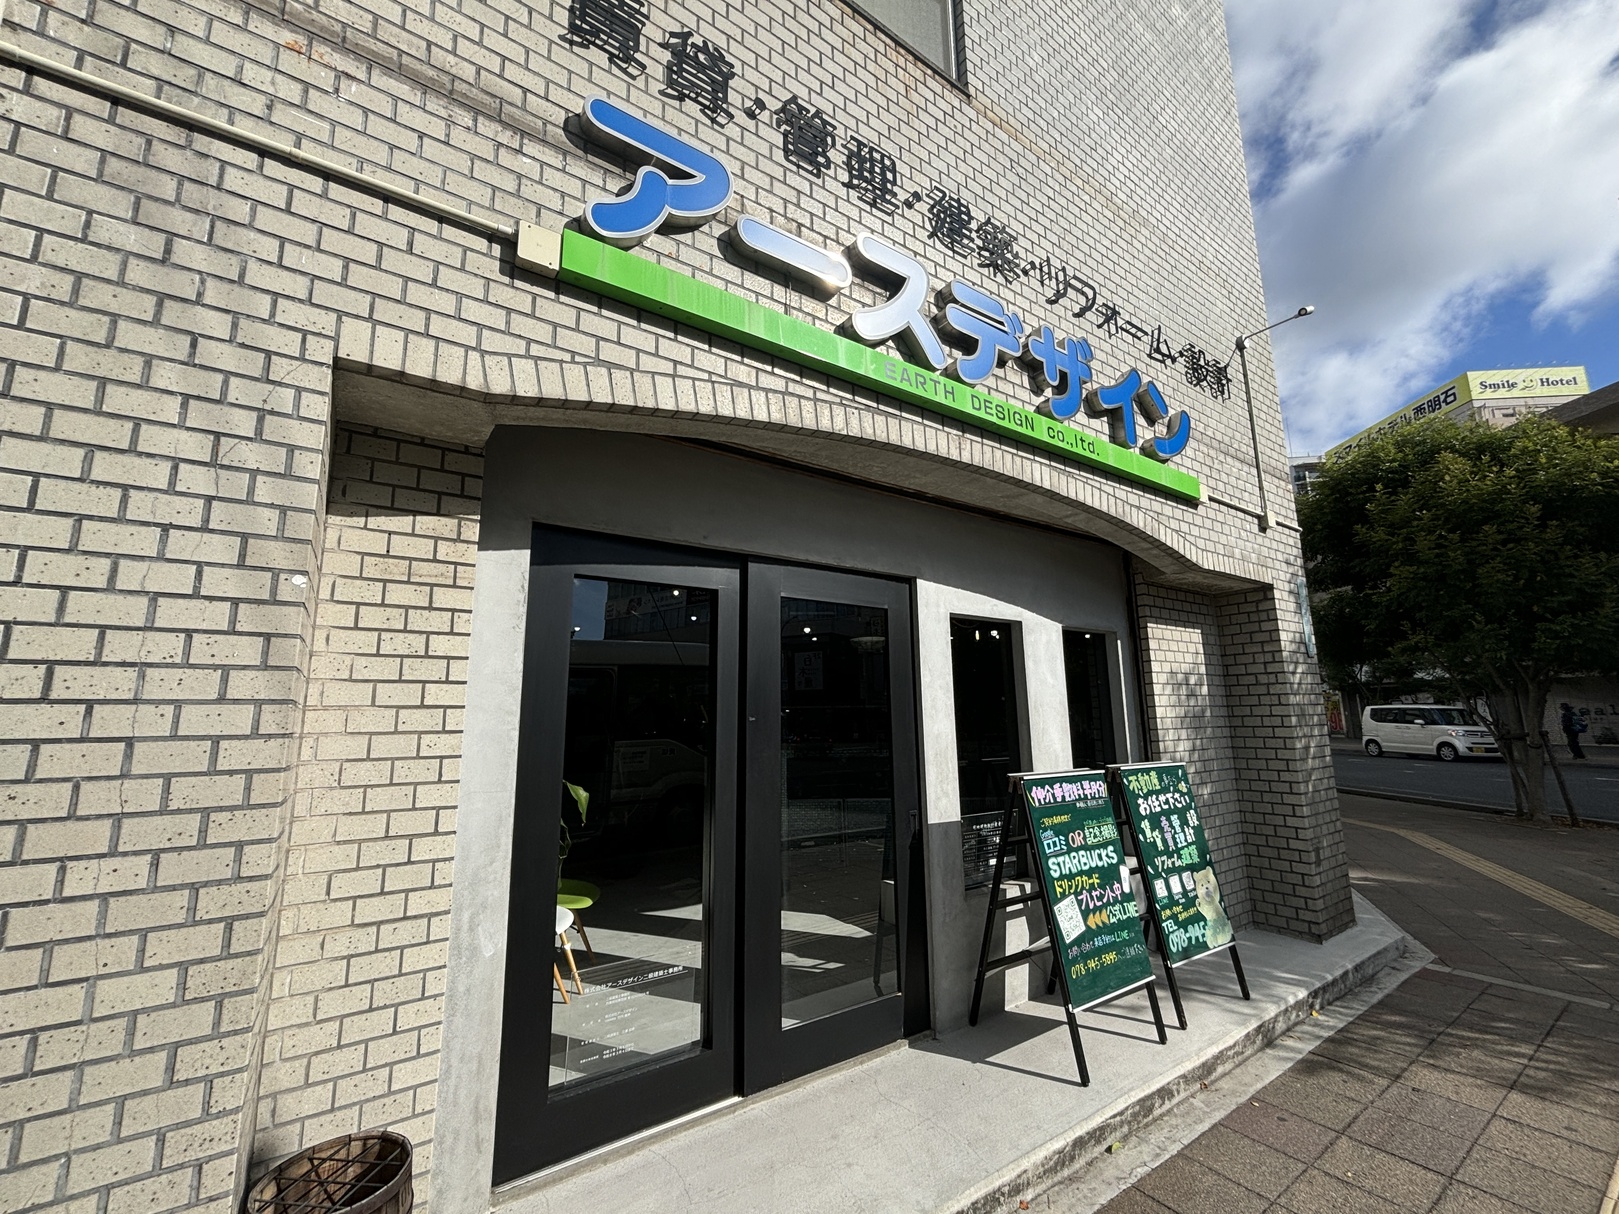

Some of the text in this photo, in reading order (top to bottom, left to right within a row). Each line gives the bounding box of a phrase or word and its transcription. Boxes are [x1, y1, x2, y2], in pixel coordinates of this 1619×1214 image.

[583, 93, 1191, 459] アースデザイン
[1479, 376, 1578, 391] Smile Hotel
[884, 361, 955, 402] EARTH
[971, 394, 1035, 432] DESIGN
[1031, 781, 1105, 806] 仲介手数料半月分
[1137, 792, 1190, 816] お任せ下さい
[1068, 829, 1085, 848] OR
[1048, 845, 1118, 879] STARBUCKS
[1054, 873, 1101, 899] ドリンクカード
[1078, 882, 1122, 911] プレゼント中
[1106, 901, 1140, 924] 公式LINE
[1162, 919, 1179, 935] TEL
